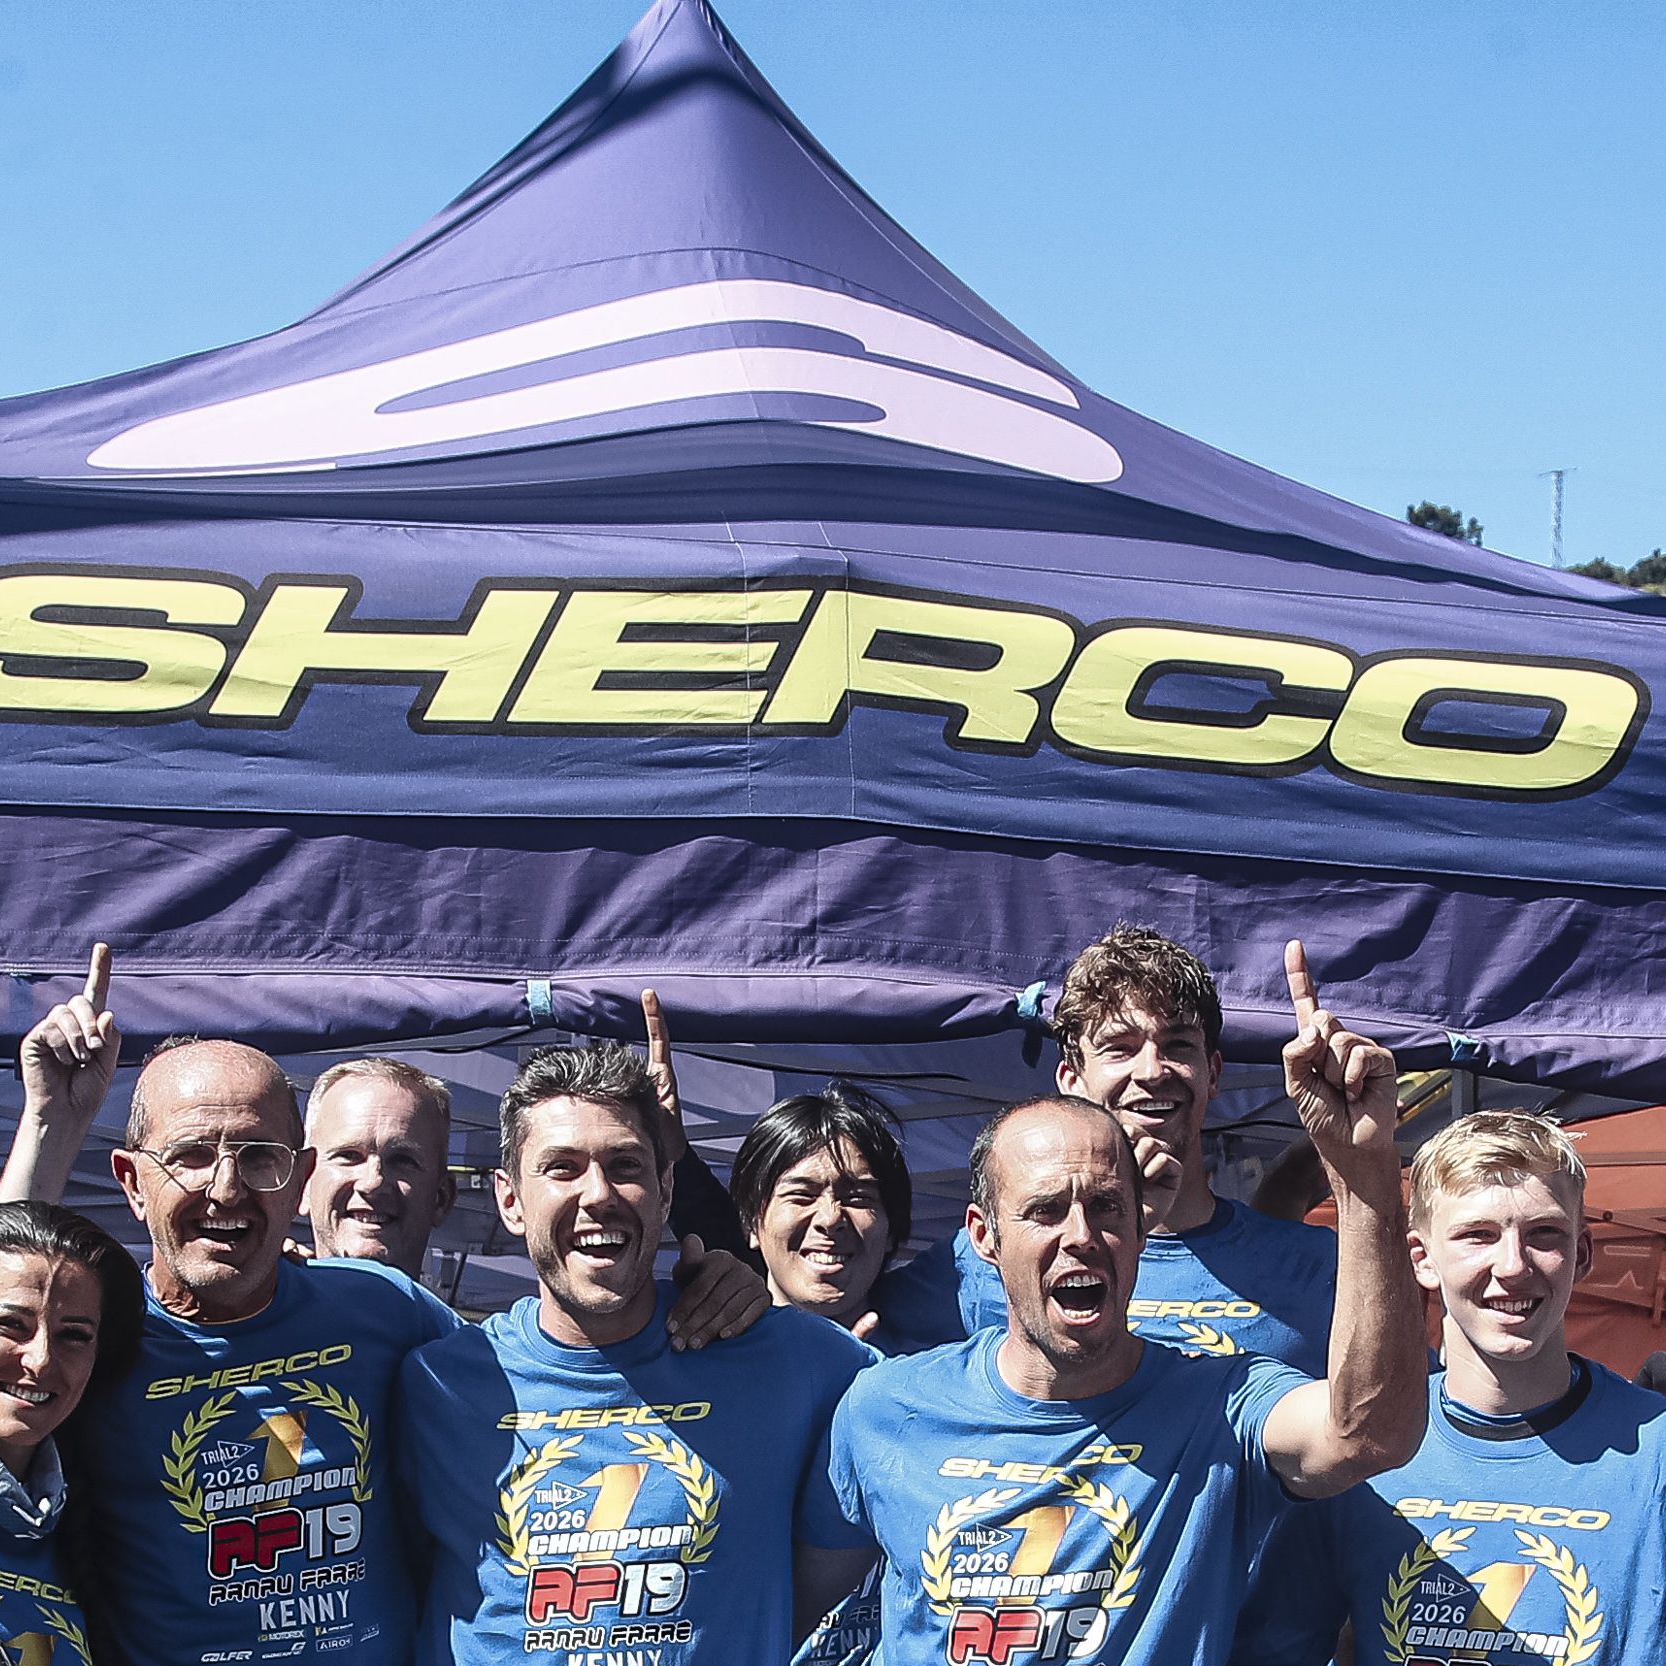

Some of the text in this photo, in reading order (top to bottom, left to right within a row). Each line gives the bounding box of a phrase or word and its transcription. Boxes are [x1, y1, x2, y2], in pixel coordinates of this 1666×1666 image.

[1126, 1299, 1260, 1318] ERCO
[145, 1344, 353, 1400] SHERCO
[497, 1401, 712, 1431] SHERCO
[202, 1463, 259, 1490] 2026
[204, 1466, 358, 1513] CHAMPION
[530, 1509, 586, 1531] 2026
[1393, 1497, 1611, 1531] SHERCO
[528, 1524, 692, 1556] CHAMPION
[954, 1552, 1008, 1573] 2026
[951, 1570, 1113, 1598] CHAMPION
[259, 1589, 351, 1631] KENNY
[1411, 1603, 1465, 1624] 2026
[1406, 1626, 1570, 1657] CHAMPION
